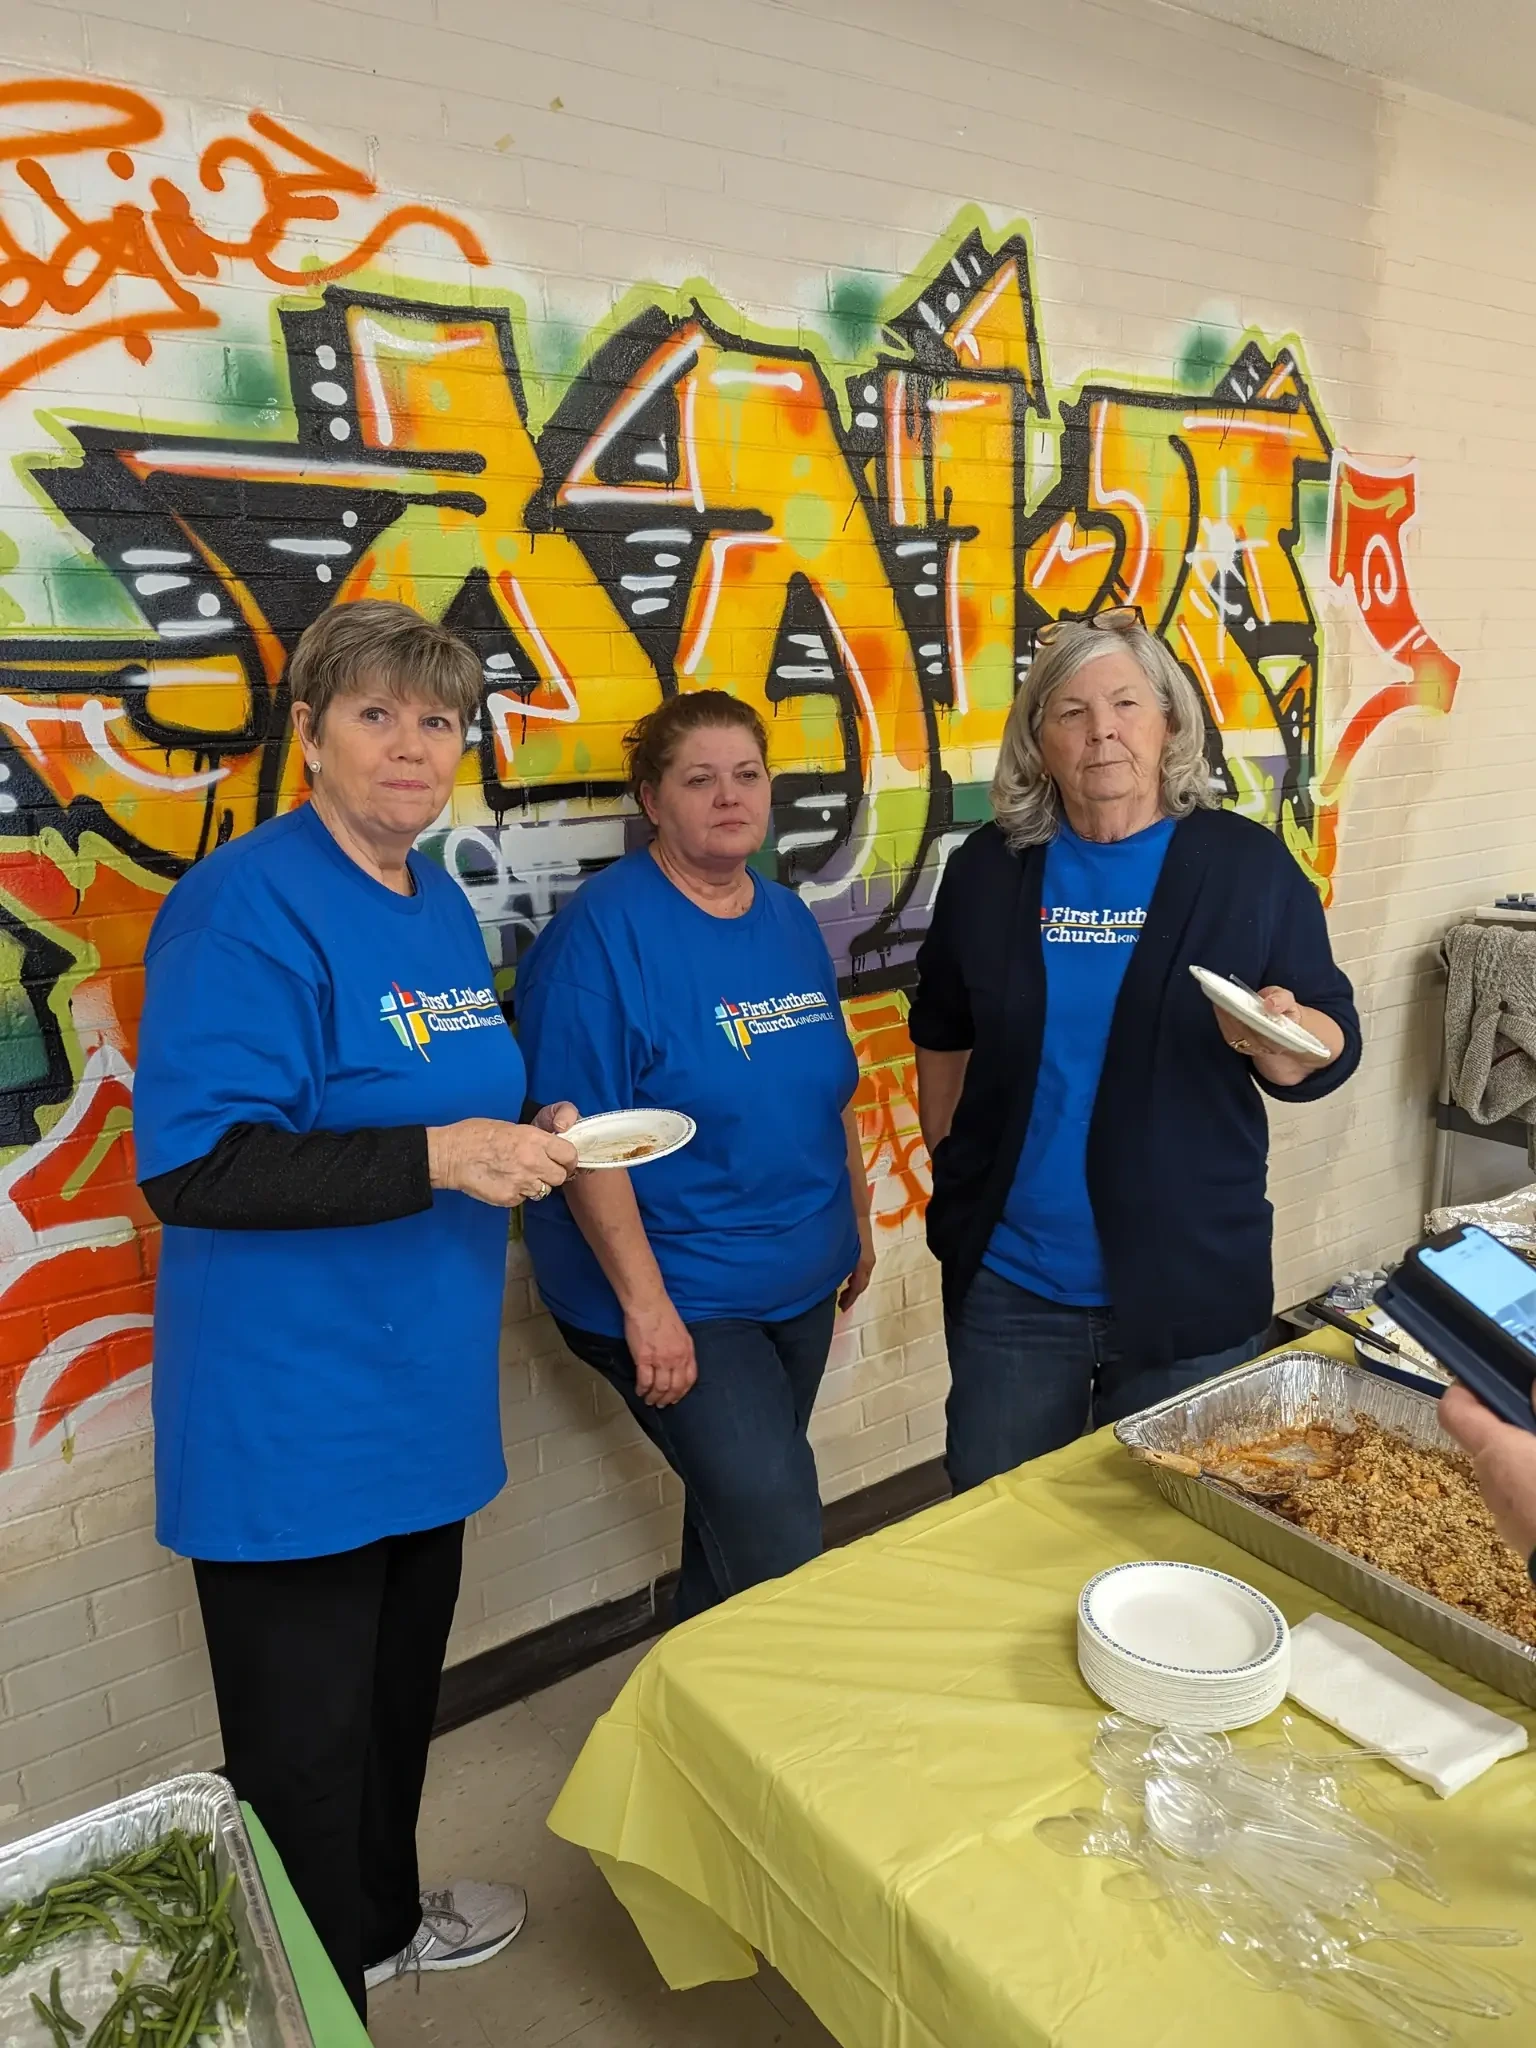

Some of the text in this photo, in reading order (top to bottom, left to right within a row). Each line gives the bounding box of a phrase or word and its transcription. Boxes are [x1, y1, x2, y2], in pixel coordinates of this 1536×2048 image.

[1050, 907, 1099, 925] First
[1046, 926, 1117, 943] Church
[415, 990, 450, 1009] First
[738, 992, 827, 1017] First Lutheran
[427, 1011, 480, 1032] Church
[748, 1014, 796, 1035] Church
